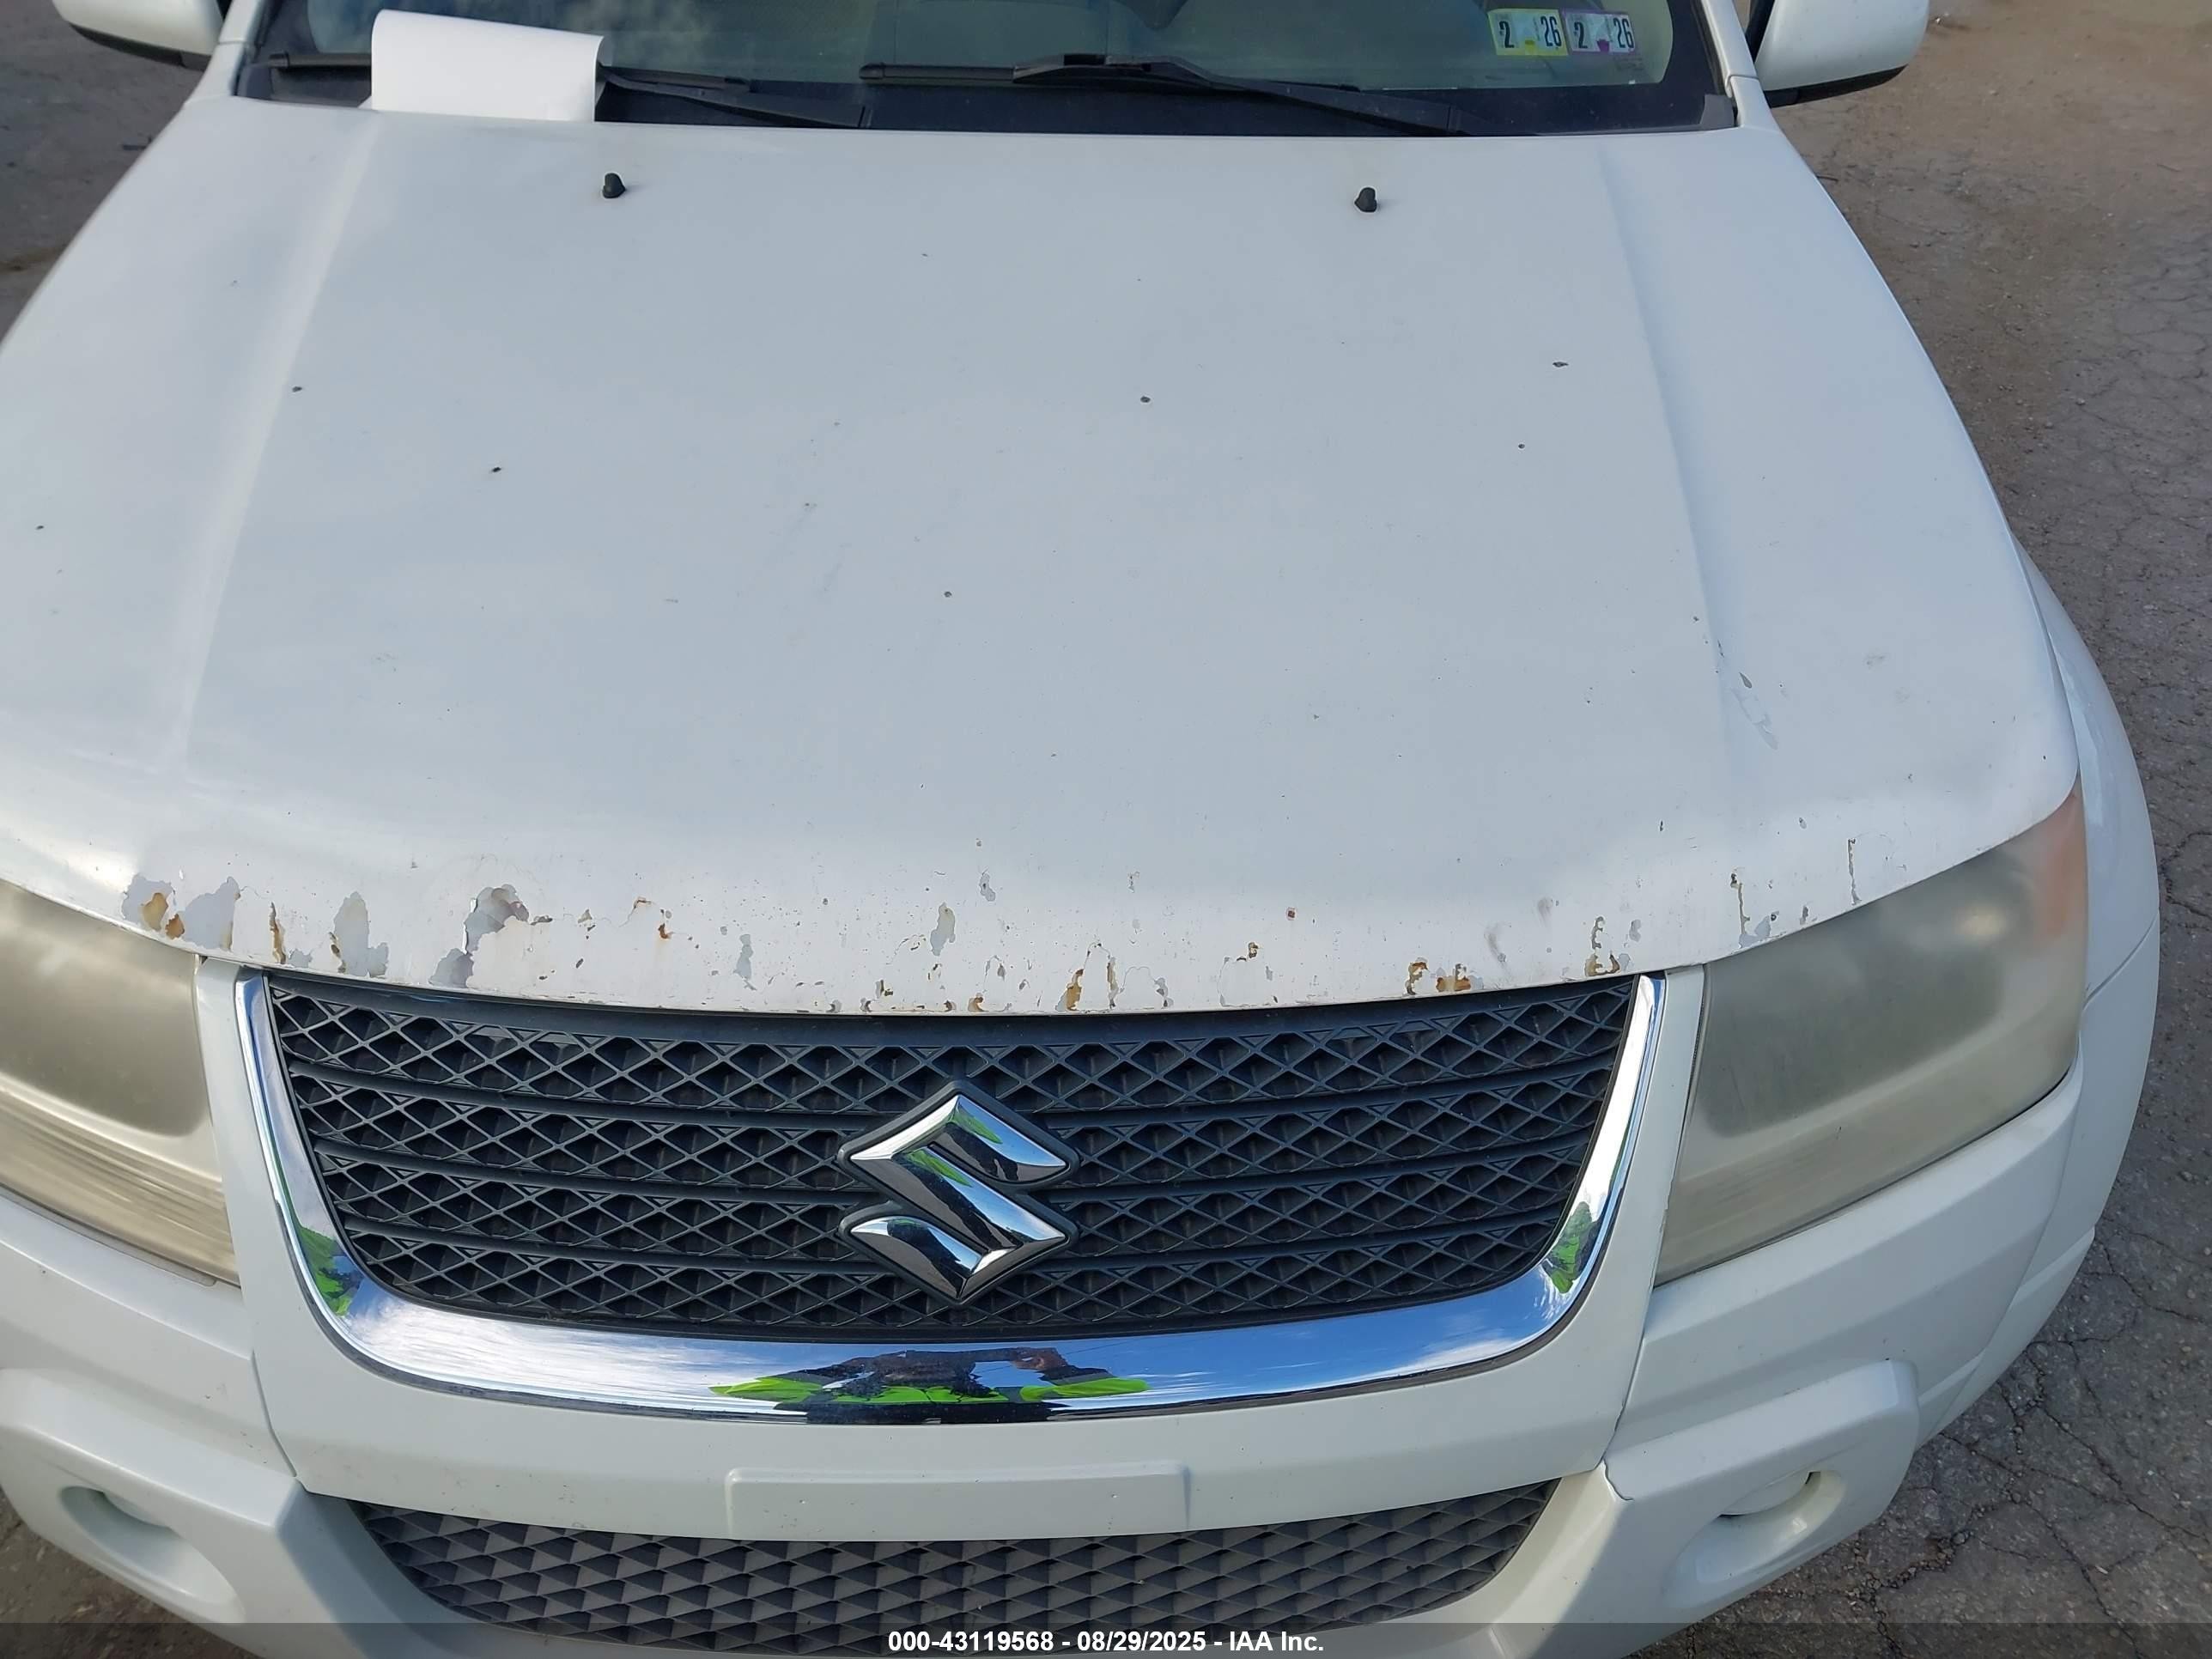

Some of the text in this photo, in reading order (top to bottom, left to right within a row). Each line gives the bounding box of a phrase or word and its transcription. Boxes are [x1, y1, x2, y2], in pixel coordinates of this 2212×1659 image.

[1498, 21, 1515, 49] 2
[1540, 15, 1562, 47] 26
[1573, 21, 1589, 49] 2
[1613, 18, 1635, 49] 26
